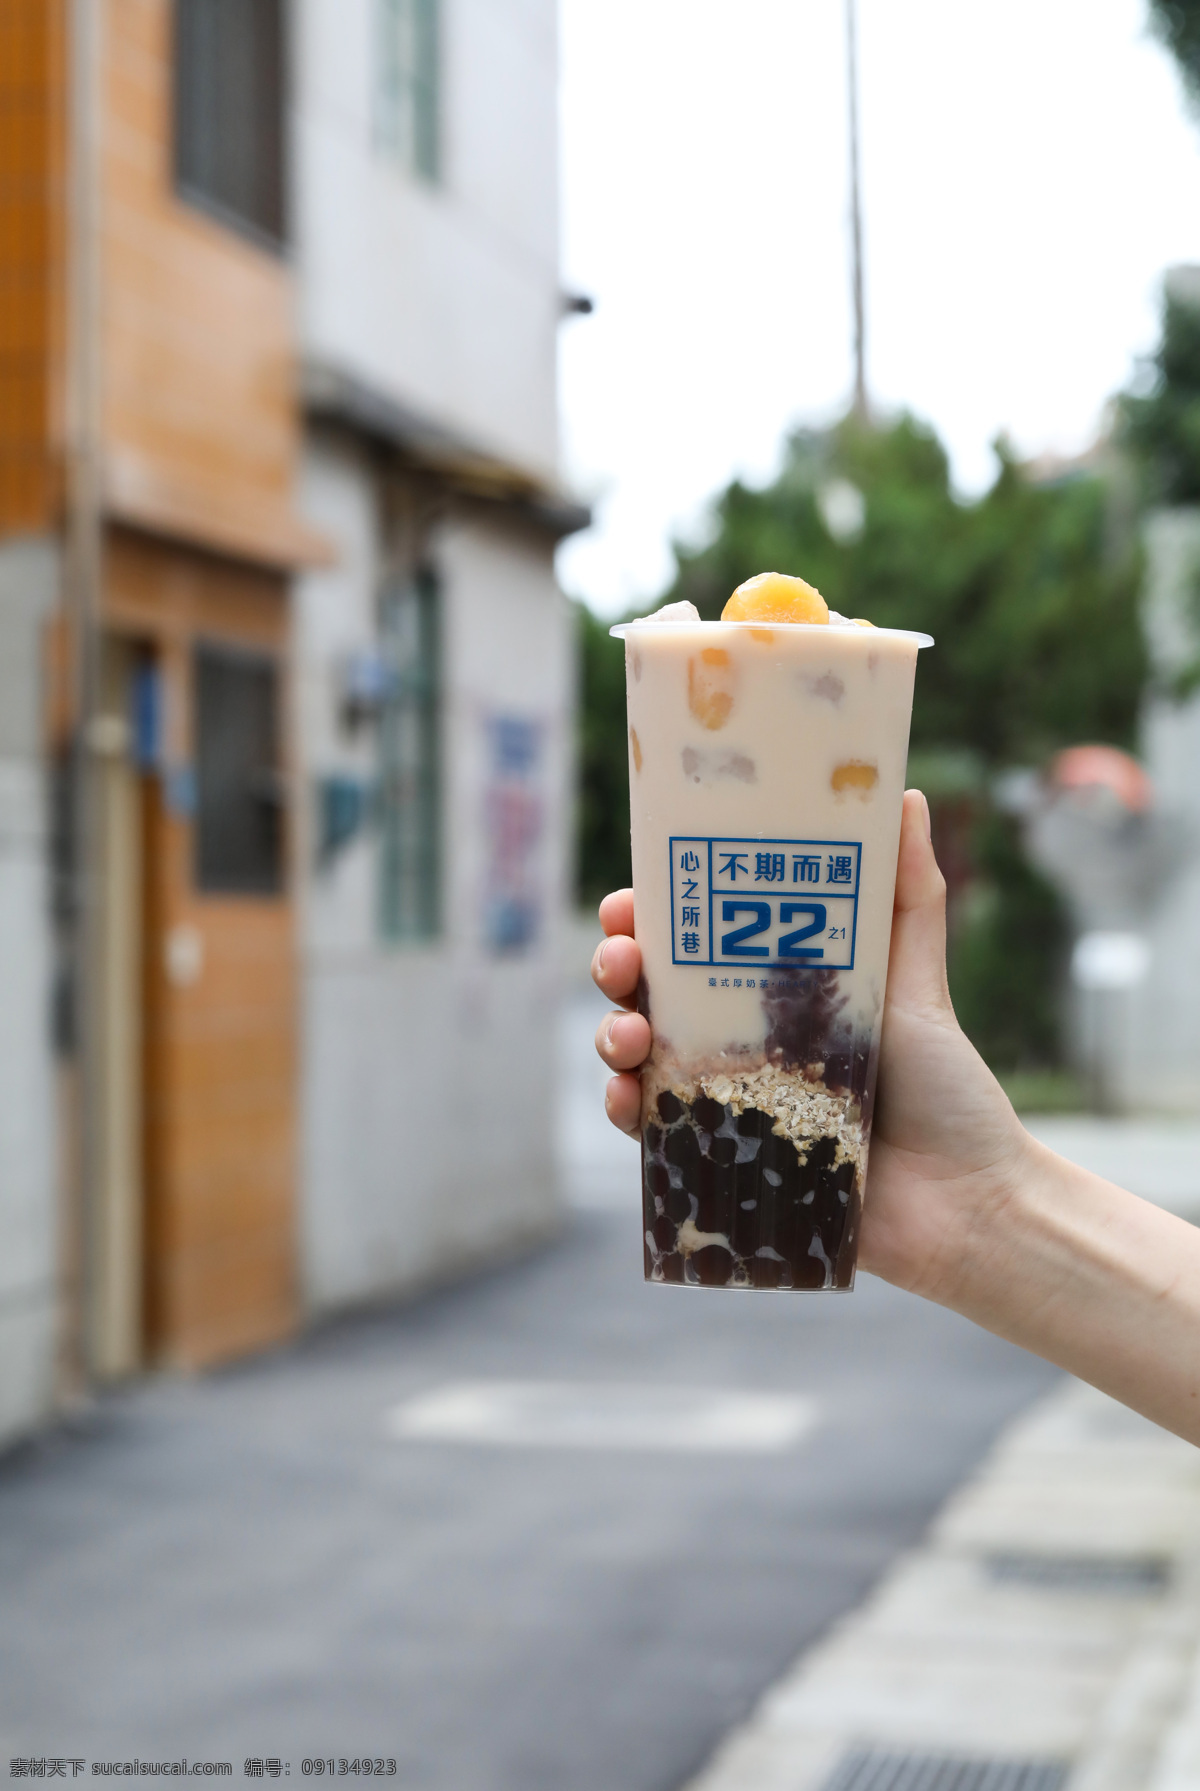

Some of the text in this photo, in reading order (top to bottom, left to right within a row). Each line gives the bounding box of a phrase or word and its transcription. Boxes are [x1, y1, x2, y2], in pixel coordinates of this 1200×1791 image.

[718, 852, 852, 884] 不期而遇
[680, 851, 700, 954] 心之所巷
[721, 900, 827, 958] 22
